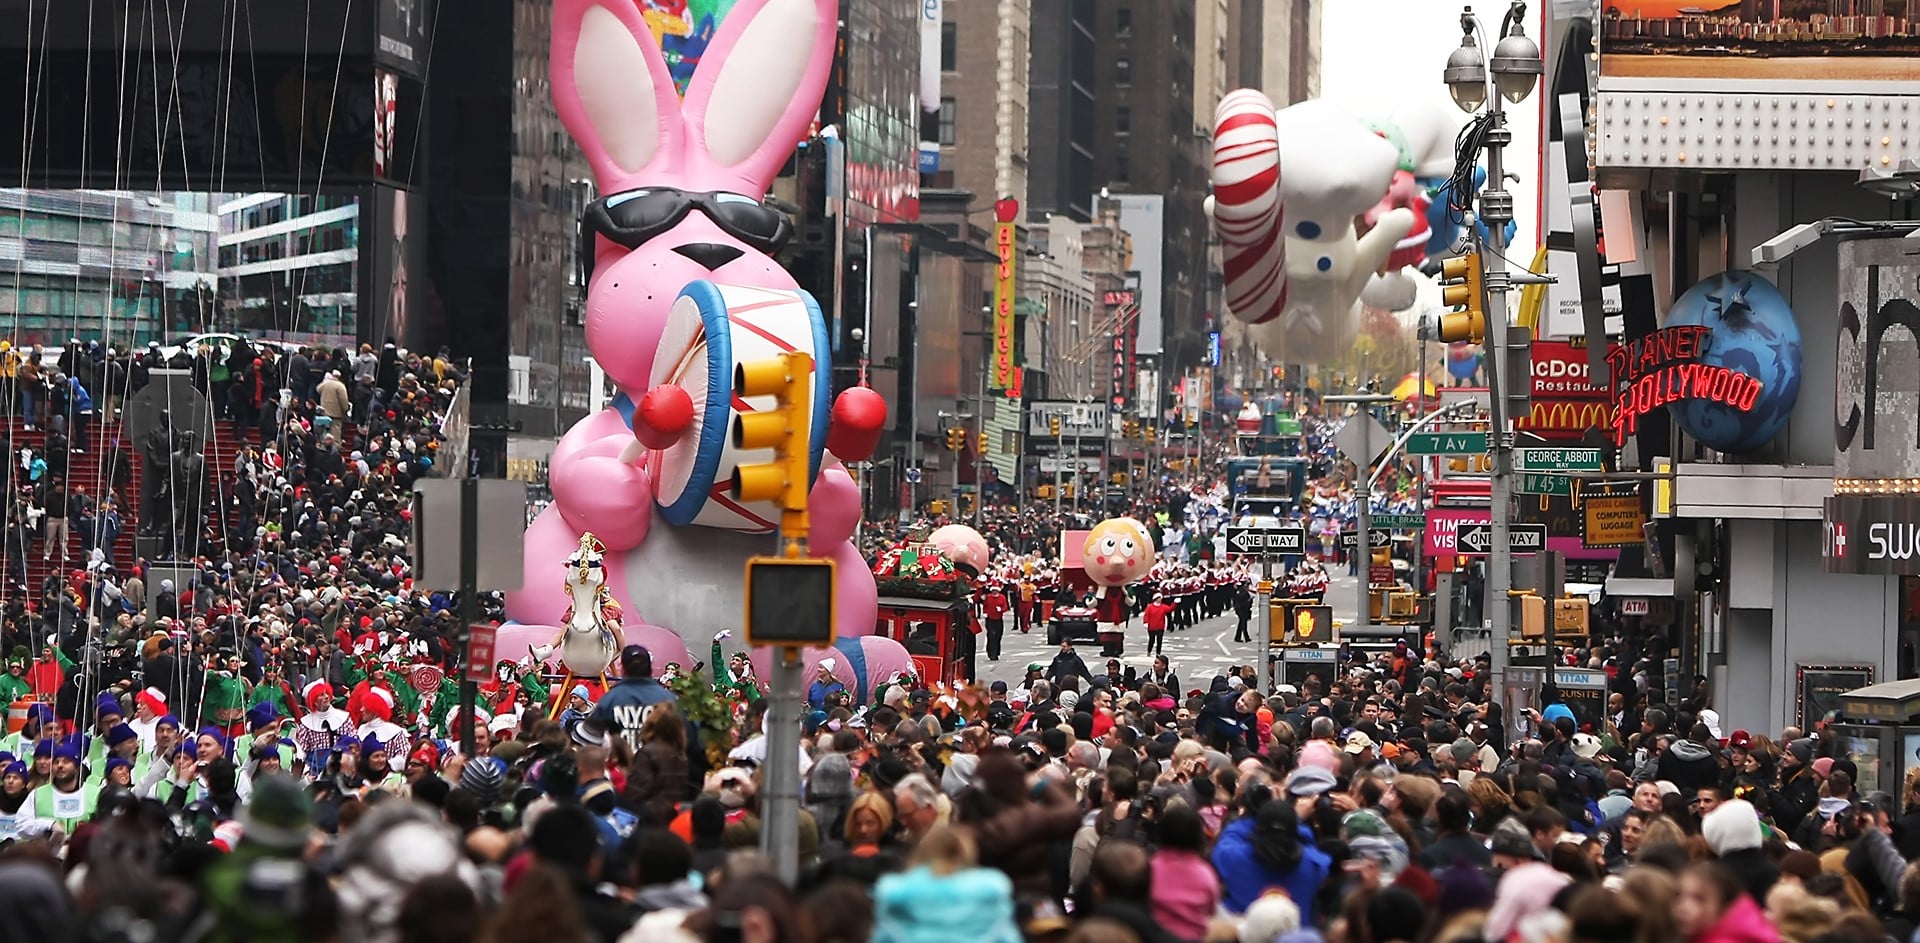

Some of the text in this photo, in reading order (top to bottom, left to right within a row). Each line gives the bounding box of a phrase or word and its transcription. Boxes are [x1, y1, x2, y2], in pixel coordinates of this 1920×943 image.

[1606, 326, 1711, 405] PLANET
[1612, 363, 1764, 447] HOLLYWOOD
[1430, 437, 1467, 451] 7 Av
[1527, 450, 1561, 463] GEORGE
[1565, 451, 1598, 463] ABBOTT
[1527, 475, 1538, 491] W
[1540, 475, 1555, 492] 45
[1559, 478, 1569, 486] ST
[1371, 515, 1425, 525] LITTLE BRAZIL
[1596, 510, 1639, 521] COMPUTERS
[1600, 521, 1633, 531] LUGGAGE
[1238, 534, 1294, 547] ONE WAY
[1347, 536, 1358, 544] ON
[1624, 601, 1648, 613] ATM
[1558, 673, 1590, 684] TITAN
